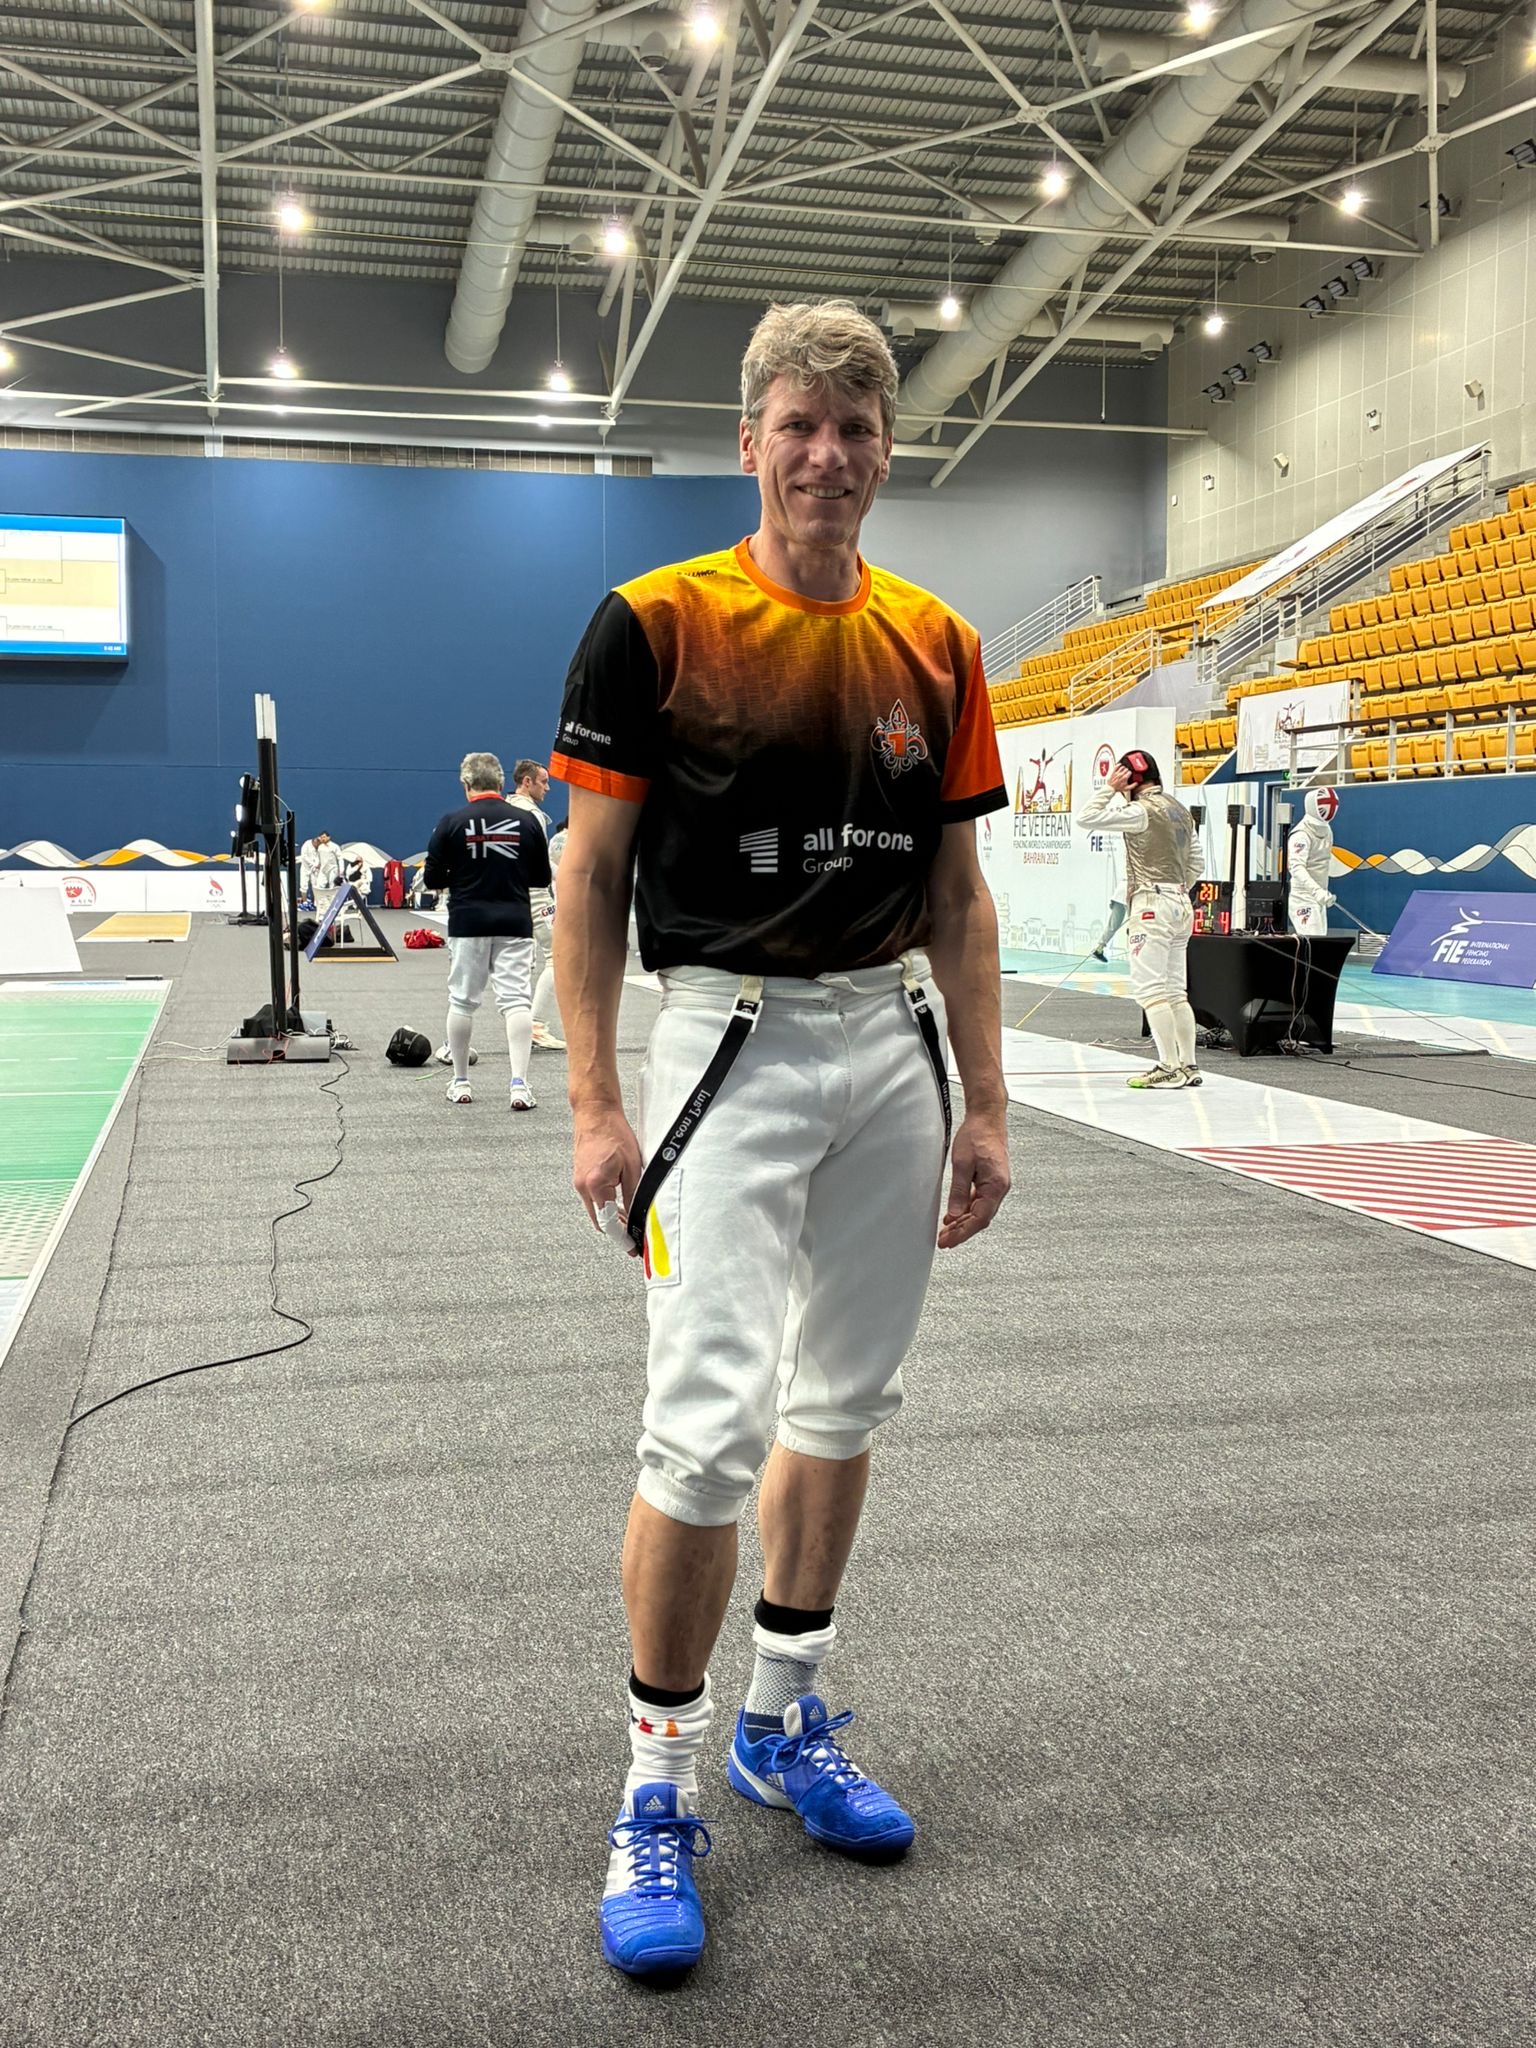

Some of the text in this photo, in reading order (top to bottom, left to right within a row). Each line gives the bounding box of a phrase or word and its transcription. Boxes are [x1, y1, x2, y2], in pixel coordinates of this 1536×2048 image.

[562, 733, 579, 746] Group
[575, 723, 591, 738] for
[591, 733, 612, 745] one
[1014, 814, 1072, 837] FIE VETERAN
[803, 823, 913, 851] all for one
[1090, 835, 1103, 852] FIE
[803, 856, 853, 874] Group
[1023, 852, 1059, 865] BAHRAIN 2025
[1220, 911, 1231, 934] 4
[1432, 939, 1470, 964] FIE
[1464, 949, 1490, 957] FENCING
[1469, 940, 1511, 950] INTERNATIONAL
[1460, 957, 1493, 966] FEDERATION
[1149, 1073, 1177, 1084] Kempa
